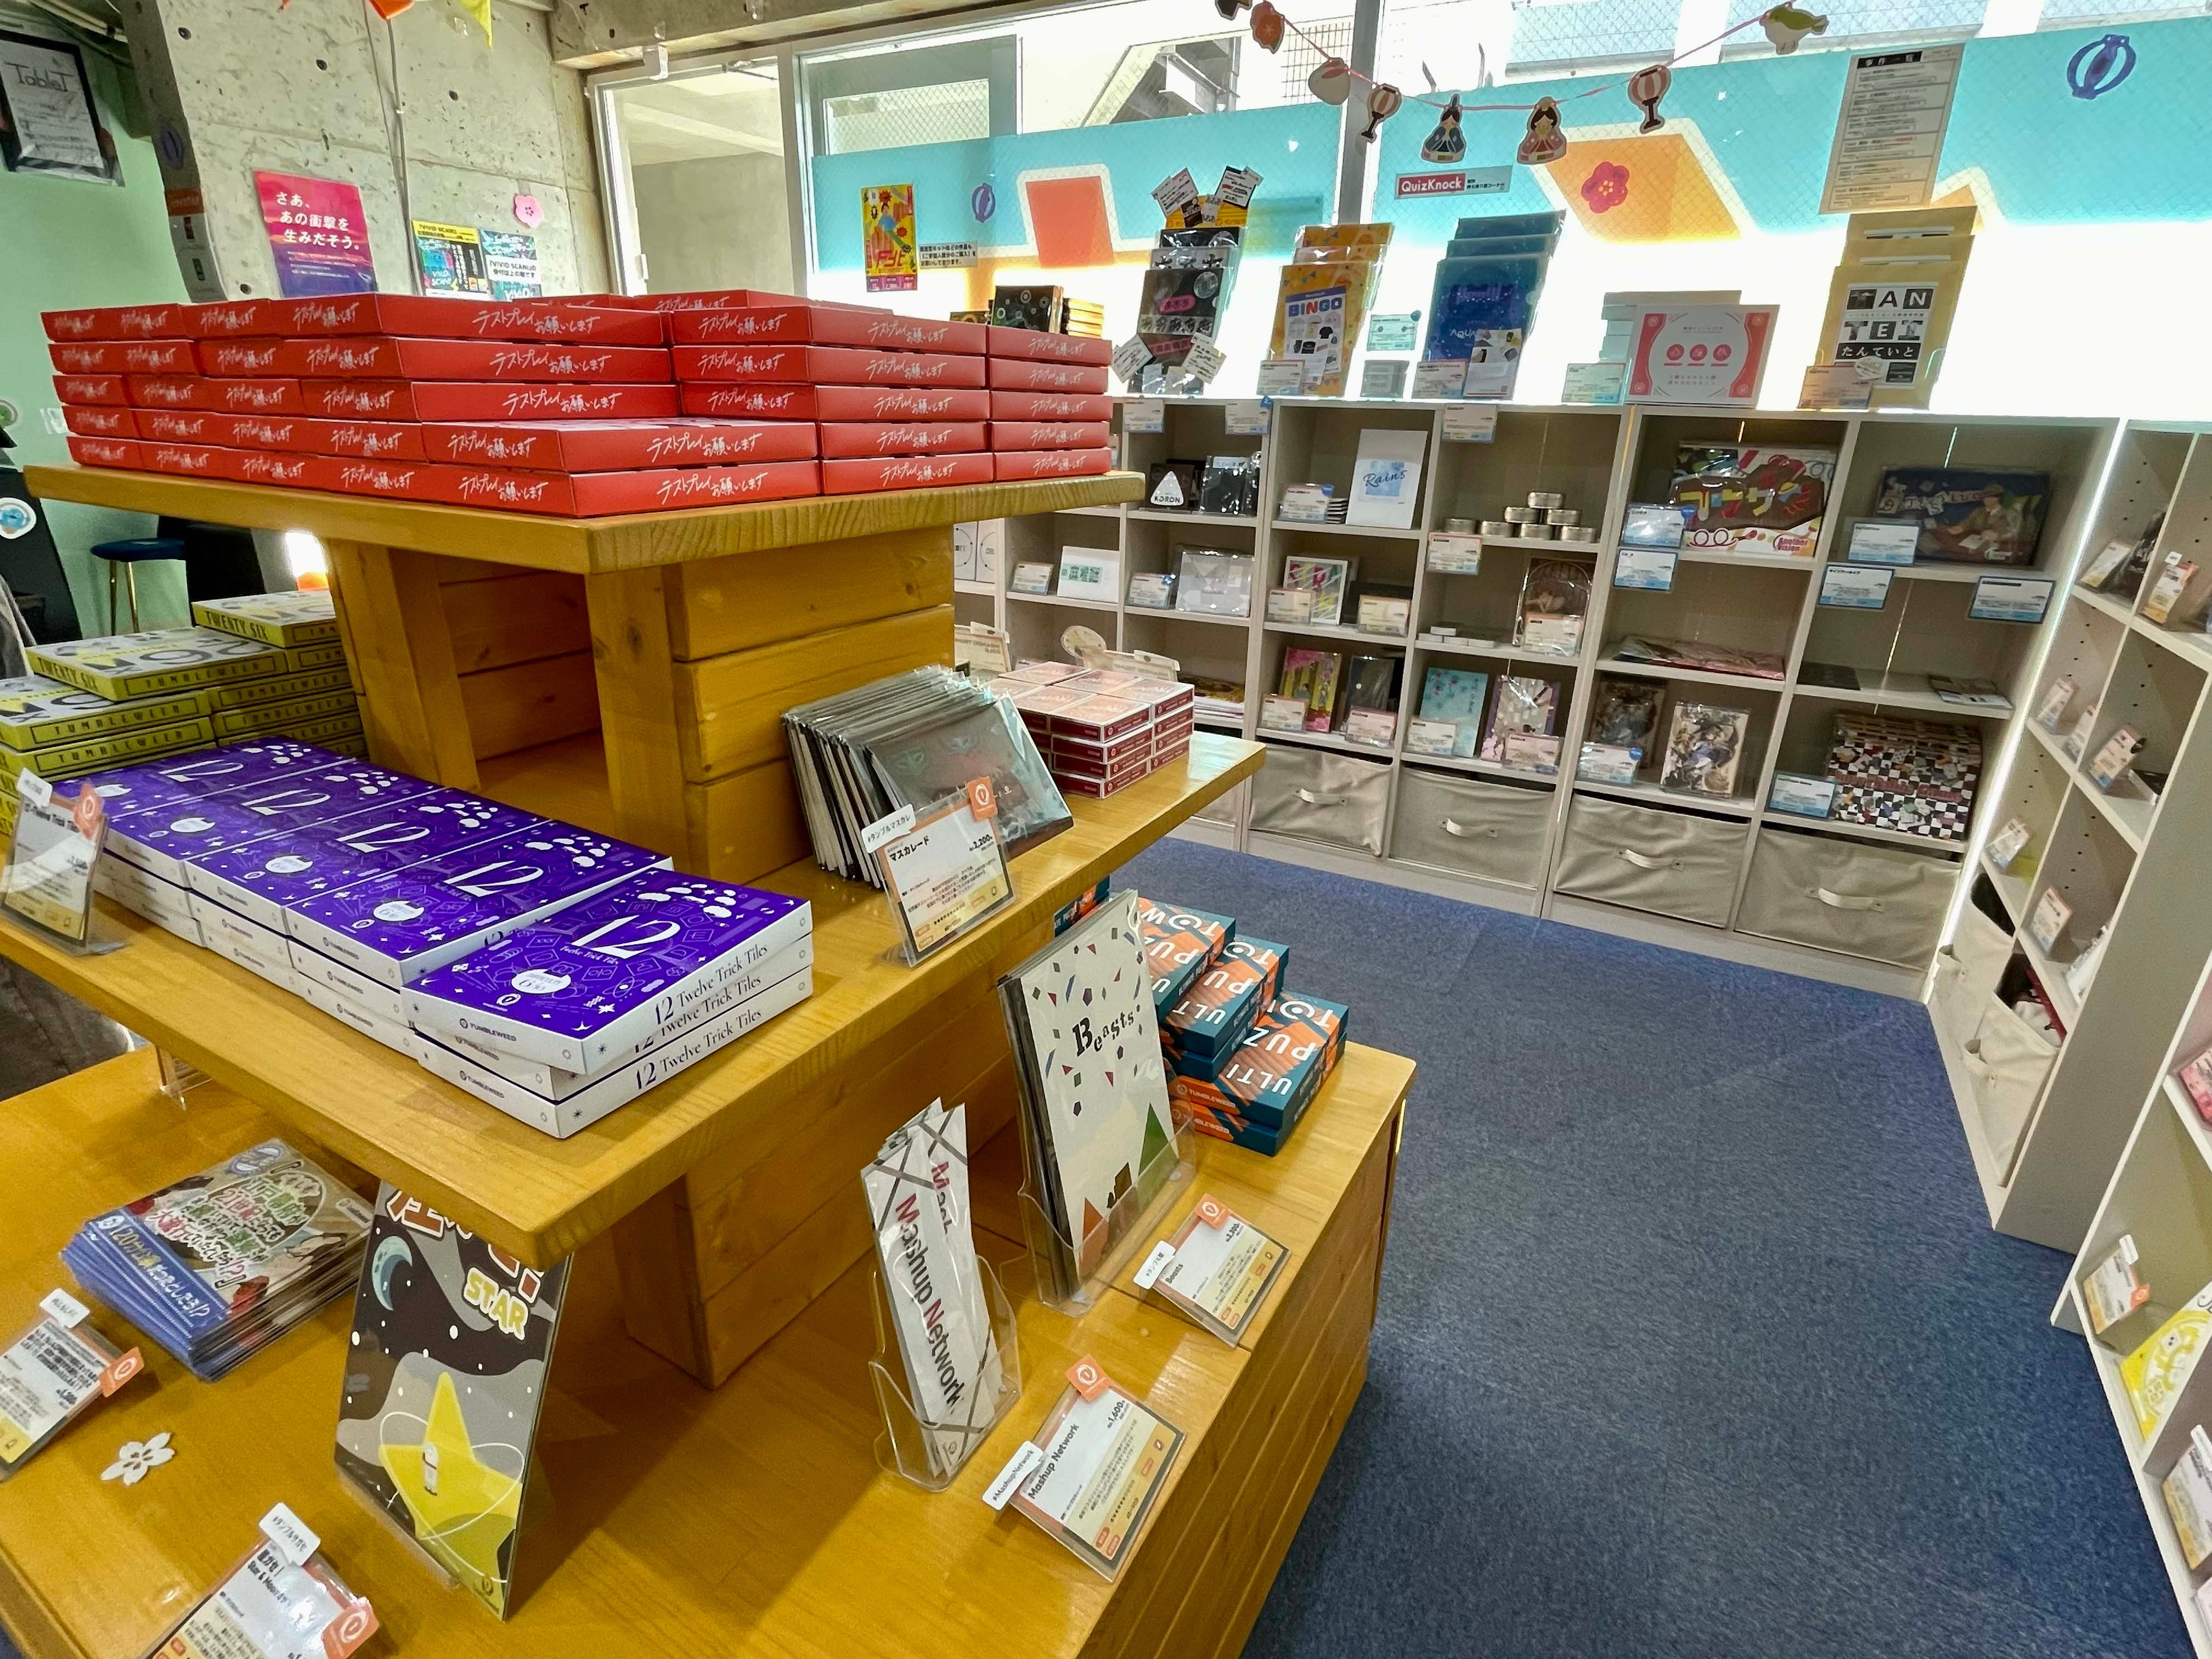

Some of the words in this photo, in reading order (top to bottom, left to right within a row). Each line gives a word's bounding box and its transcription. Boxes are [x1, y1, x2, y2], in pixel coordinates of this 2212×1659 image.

[1401, 177, 1462, 192] QuizKnock
[276, 192, 309, 208] さあ、
[280, 211, 349, 231] あの衝撃を
[284, 229, 359, 250] 生みだそう。
[472, 307, 600, 334] テストプレイお願いします
[1289, 297, 1342, 317] BINGO
[698, 313, 787, 338] テストプレイお願いします
[489, 348, 612, 375] テストプレイお願いします
[698, 351, 785, 375] テストプレイお願いします
[503, 389, 622, 415] テストプレイお願いします
[647, 432, 763, 462] テストプレイお願いします
[657, 472, 768, 504] テストプレイお願いします
[1363, 470, 1408, 488] Rains
[205, 611, 248, 637] TWENTY
[250, 622, 268, 640] SIX
[38, 656, 80, 685] TWENTY
[81, 673, 99, 692] SIX
[54, 706, 181, 736] TUMBLEWEED
[58, 730, 183, 764] TUMBLEWEED
[890, 836, 929, 861] マスカレード
[445, 860, 544, 898] 12
[571, 915, 681, 959] 12
[656, 996, 675, 1025] 12
[678, 979, 715, 1007] Twelve
[716, 960, 744, 985] Trick
[746, 943, 768, 967] Tiles
[701, 989, 733, 1014] Trick
[735, 973, 761, 996] Tiles
[470, 1022, 516, 1042] TUMBLEWEED
[1073, 1010, 1135, 1058] Beasts
[635, 1062, 657, 1091] 12
[661, 1043, 702, 1075] Twelve
[703, 1025, 734, 1049] Trick
[736, 1007, 762, 1030] Tiles
[467, 1076, 504, 1098] TUMBLEWEED
[1188, 1088, 1236, 1109] TUMBLEWEED
[1165, 1263, 1183, 1284] Beasts
[465, 1268, 529, 1340] STAR
[895, 1193, 934, 1304] Mashup
[924, 1299, 966, 1414] Network
[993, 1449, 1034, 1501] #MashupNetwork
[1028, 1462, 1056, 1500] Mashup
[1054, 1424, 1080, 1461] Network
